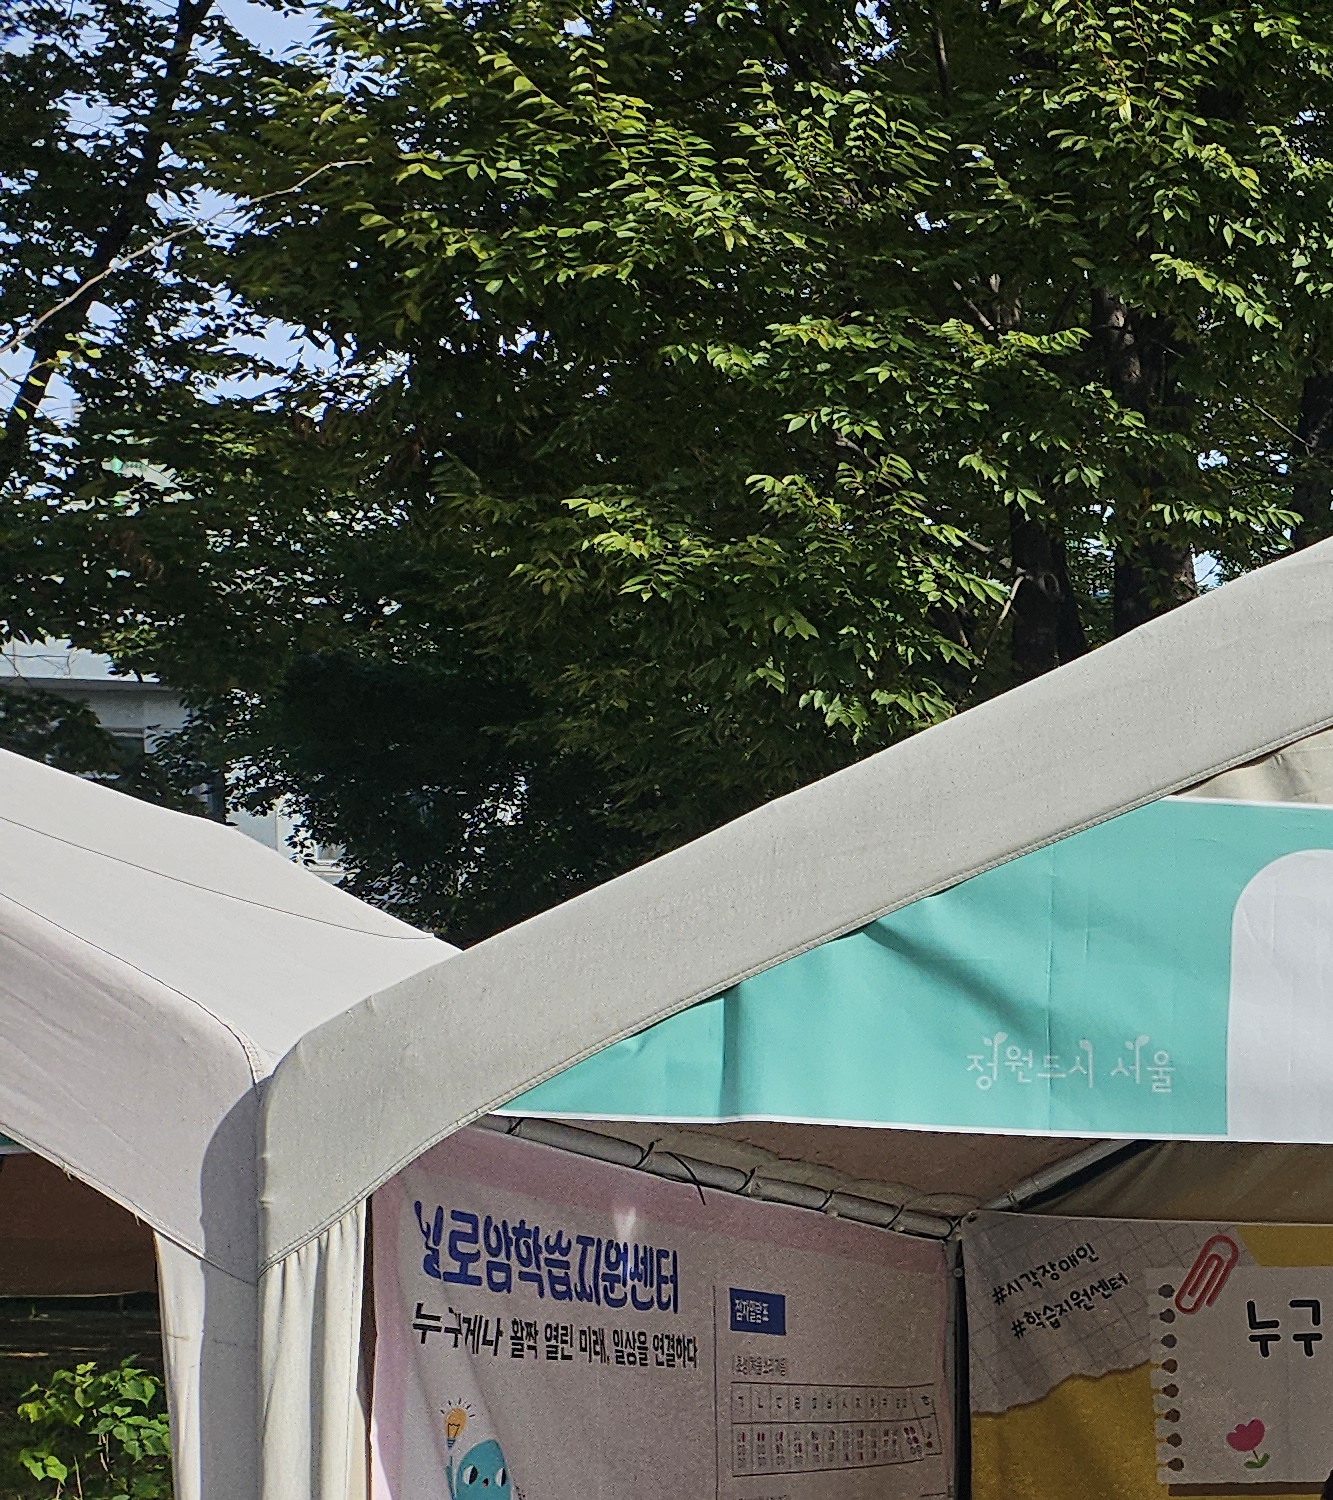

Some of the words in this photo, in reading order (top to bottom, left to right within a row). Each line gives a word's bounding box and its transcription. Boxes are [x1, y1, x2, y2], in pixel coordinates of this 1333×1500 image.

[1110, 1035, 1174, 1094] 서울
[991, 1242, 1100, 1305] #시각장애인
[1011, 1272, 1129, 1339] #학습지원센터
[509, 1317, 539, 1359] 활짝
[544, 1323, 573, 1361] 열린
[579, 1326, 610, 1366] 미래,
[612, 1329, 649, 1367] 일상을
[652, 1332, 699, 1369] 연결하다
